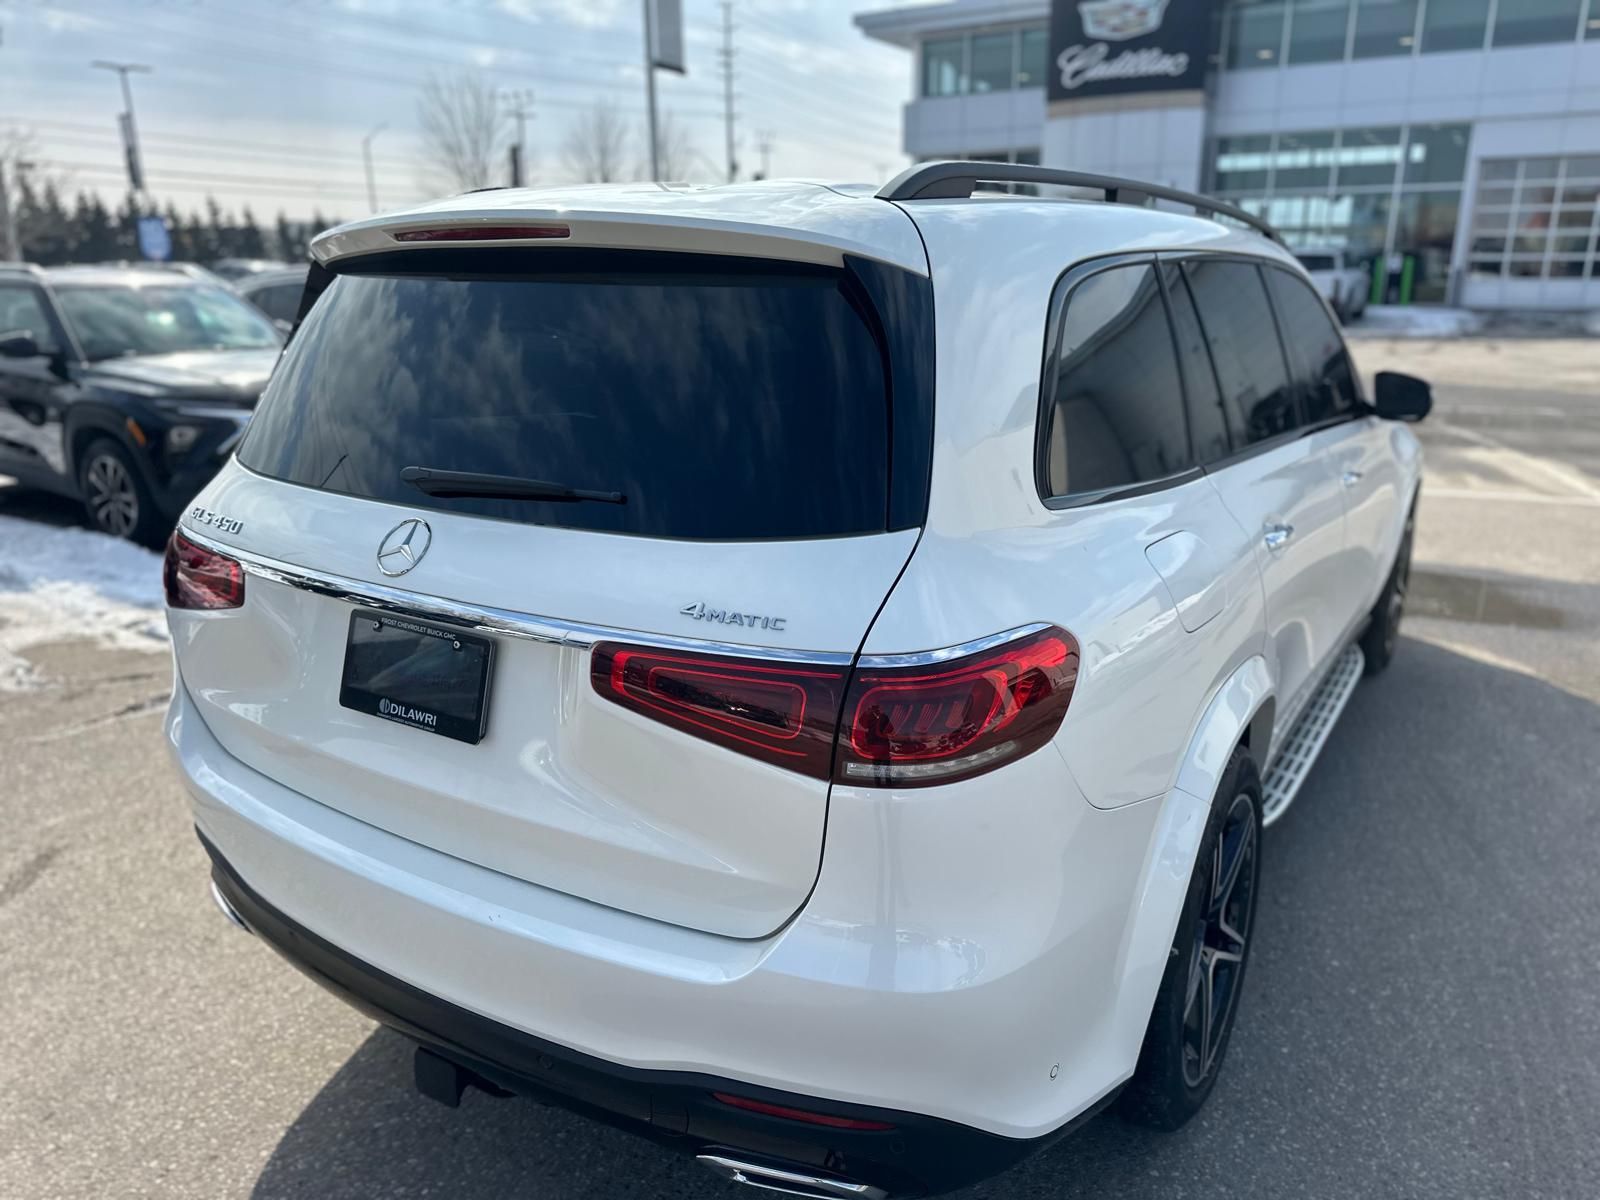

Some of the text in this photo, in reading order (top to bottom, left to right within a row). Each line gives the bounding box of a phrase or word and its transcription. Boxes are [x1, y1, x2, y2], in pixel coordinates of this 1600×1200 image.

[1057, 42, 1189, 89] Cadillac
[191, 507, 244, 535] GLS 450
[381, 617, 456, 640] FROST CHEVROLET BUICK GMC
[679, 601, 787, 631] 4MATIC
[390, 703, 437, 726] DILAWRI
